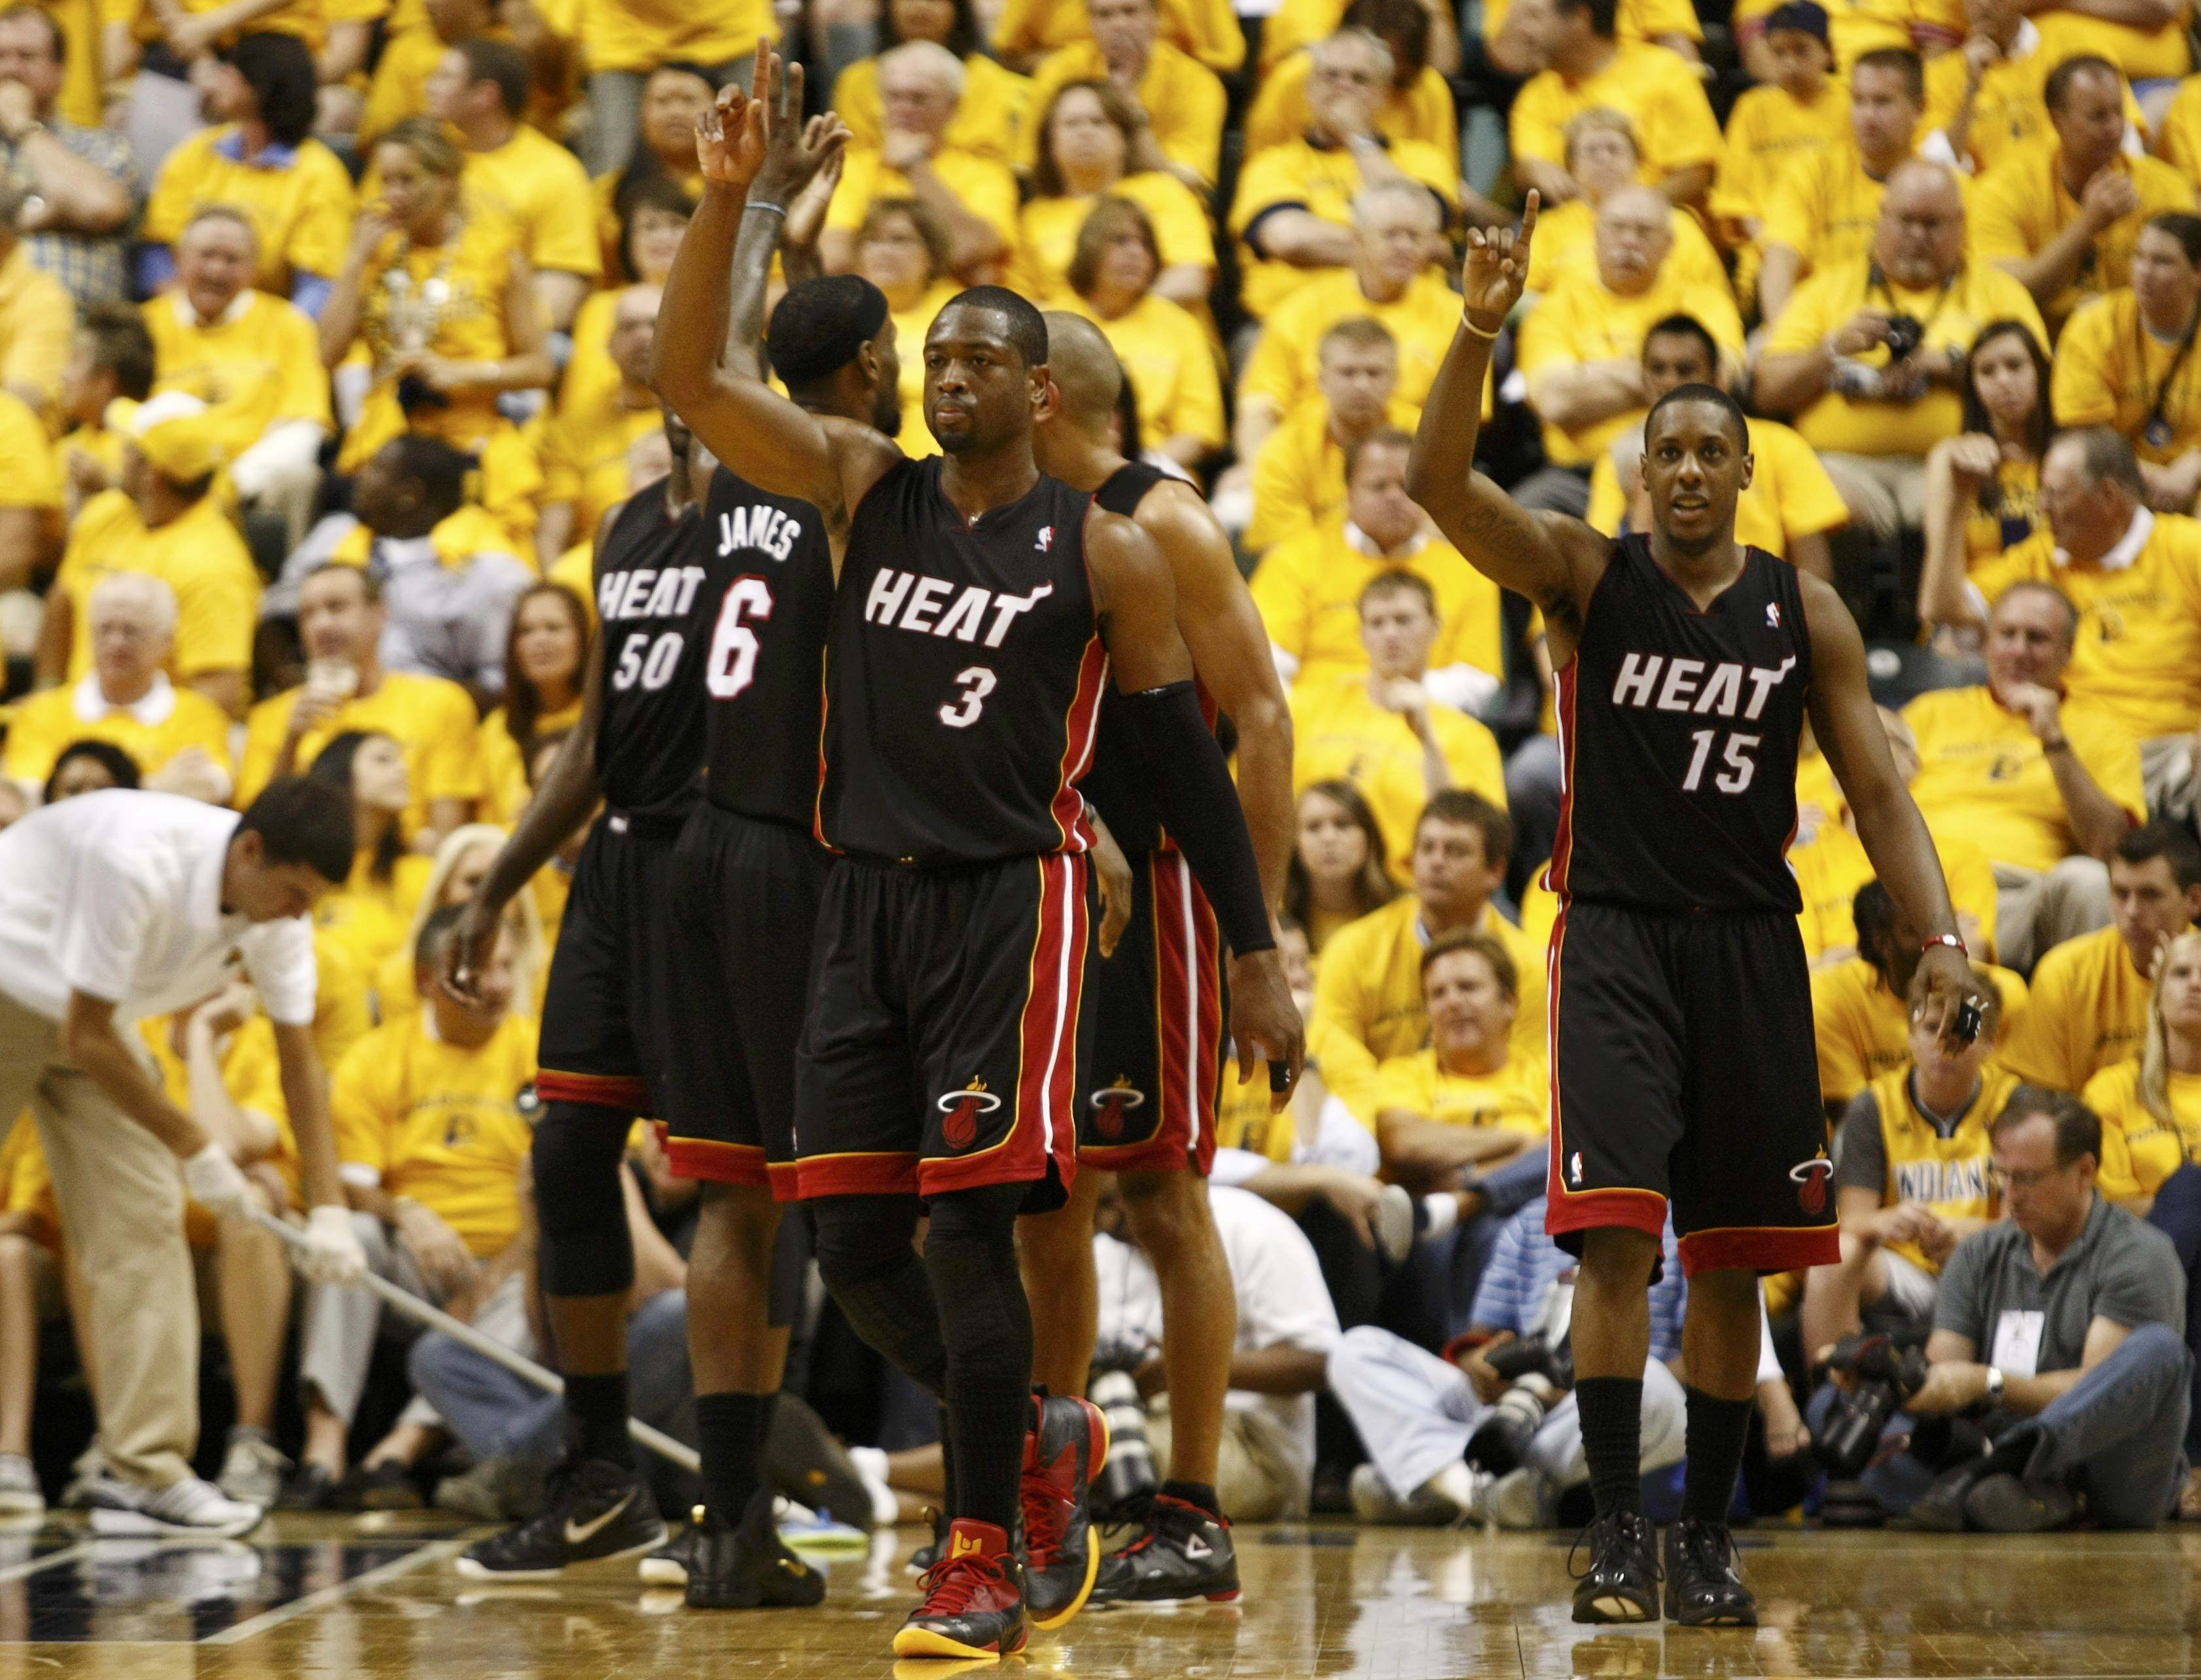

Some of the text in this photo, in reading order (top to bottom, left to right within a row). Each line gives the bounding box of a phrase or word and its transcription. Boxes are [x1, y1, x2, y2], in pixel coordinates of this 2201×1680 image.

[717, 504, 802, 563] JAMES
[597, 565, 706, 621] HEAT
[865, 567, 1054, 649] HEAT
[612, 632, 685, 691] 50
[706, 573, 775, 700] 6
[938, 666, 998, 728] 3
[1612, 652, 1797, 720] HEAT
[1681, 729, 1762, 794] 15
